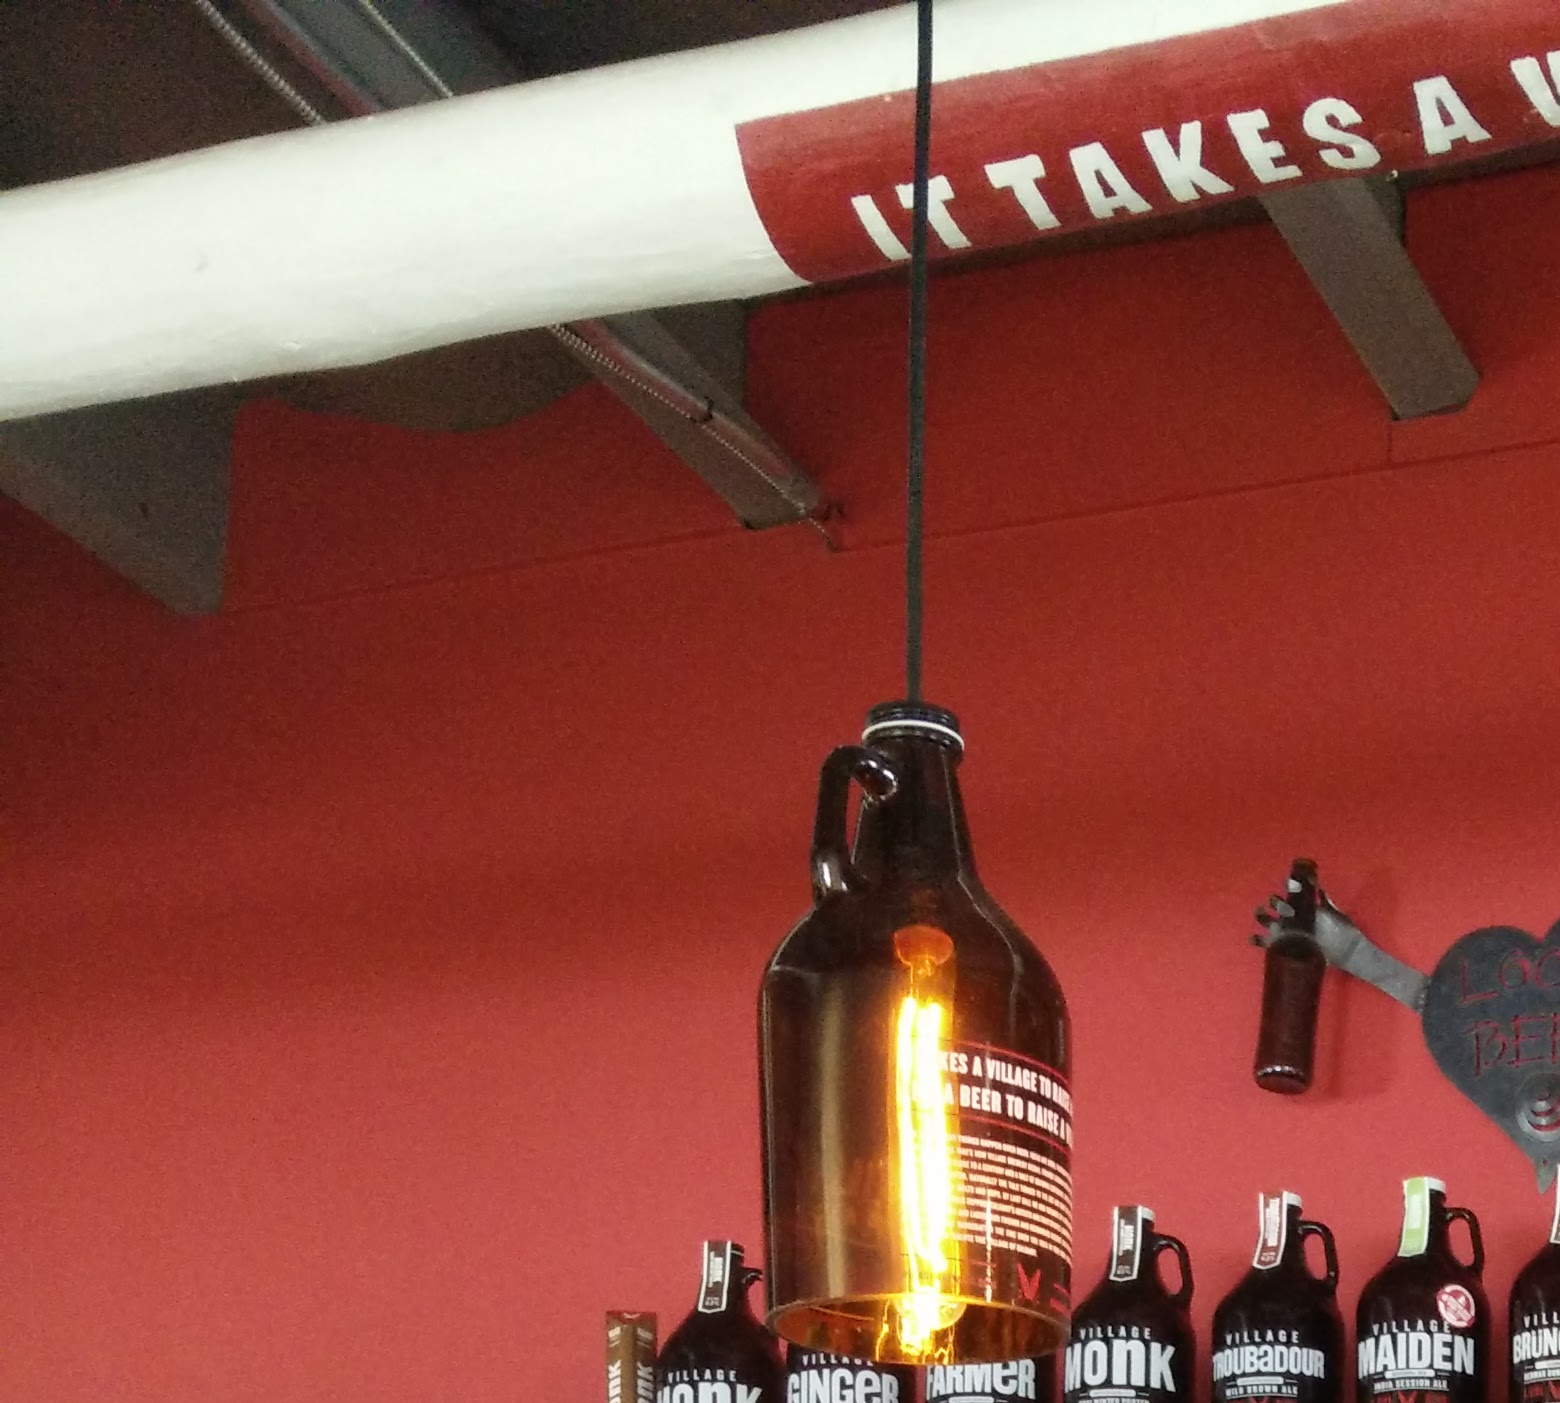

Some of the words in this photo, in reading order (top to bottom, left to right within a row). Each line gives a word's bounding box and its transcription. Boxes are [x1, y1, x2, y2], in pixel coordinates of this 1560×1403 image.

[851, 175, 972, 261] IT
[984, 97, 1380, 230] TAKES
[1410, 76, 1491, 154] A
[972, 1056, 982, 1077] A
[986, 1058, 1037, 1092] VILLAGE
[960, 1085, 1001, 1114] BEER
[1005, 1093, 1023, 1120] TO
[1028, 1100, 1059, 1136] RAISE
[1080, 1325, 1151, 1340] VILLAGE
[1373, 1319, 1450, 1336] VILLAGE
[1225, 1330, 1300, 1345] VILLAGE
[1358, 1332, 1475, 1380] MAIDEN
[668, 1369, 737, 1382] VILLAGE
[1395, 1379, 1431, 1389] SESSION
[1433, 1379, 1448, 1389] ALE
